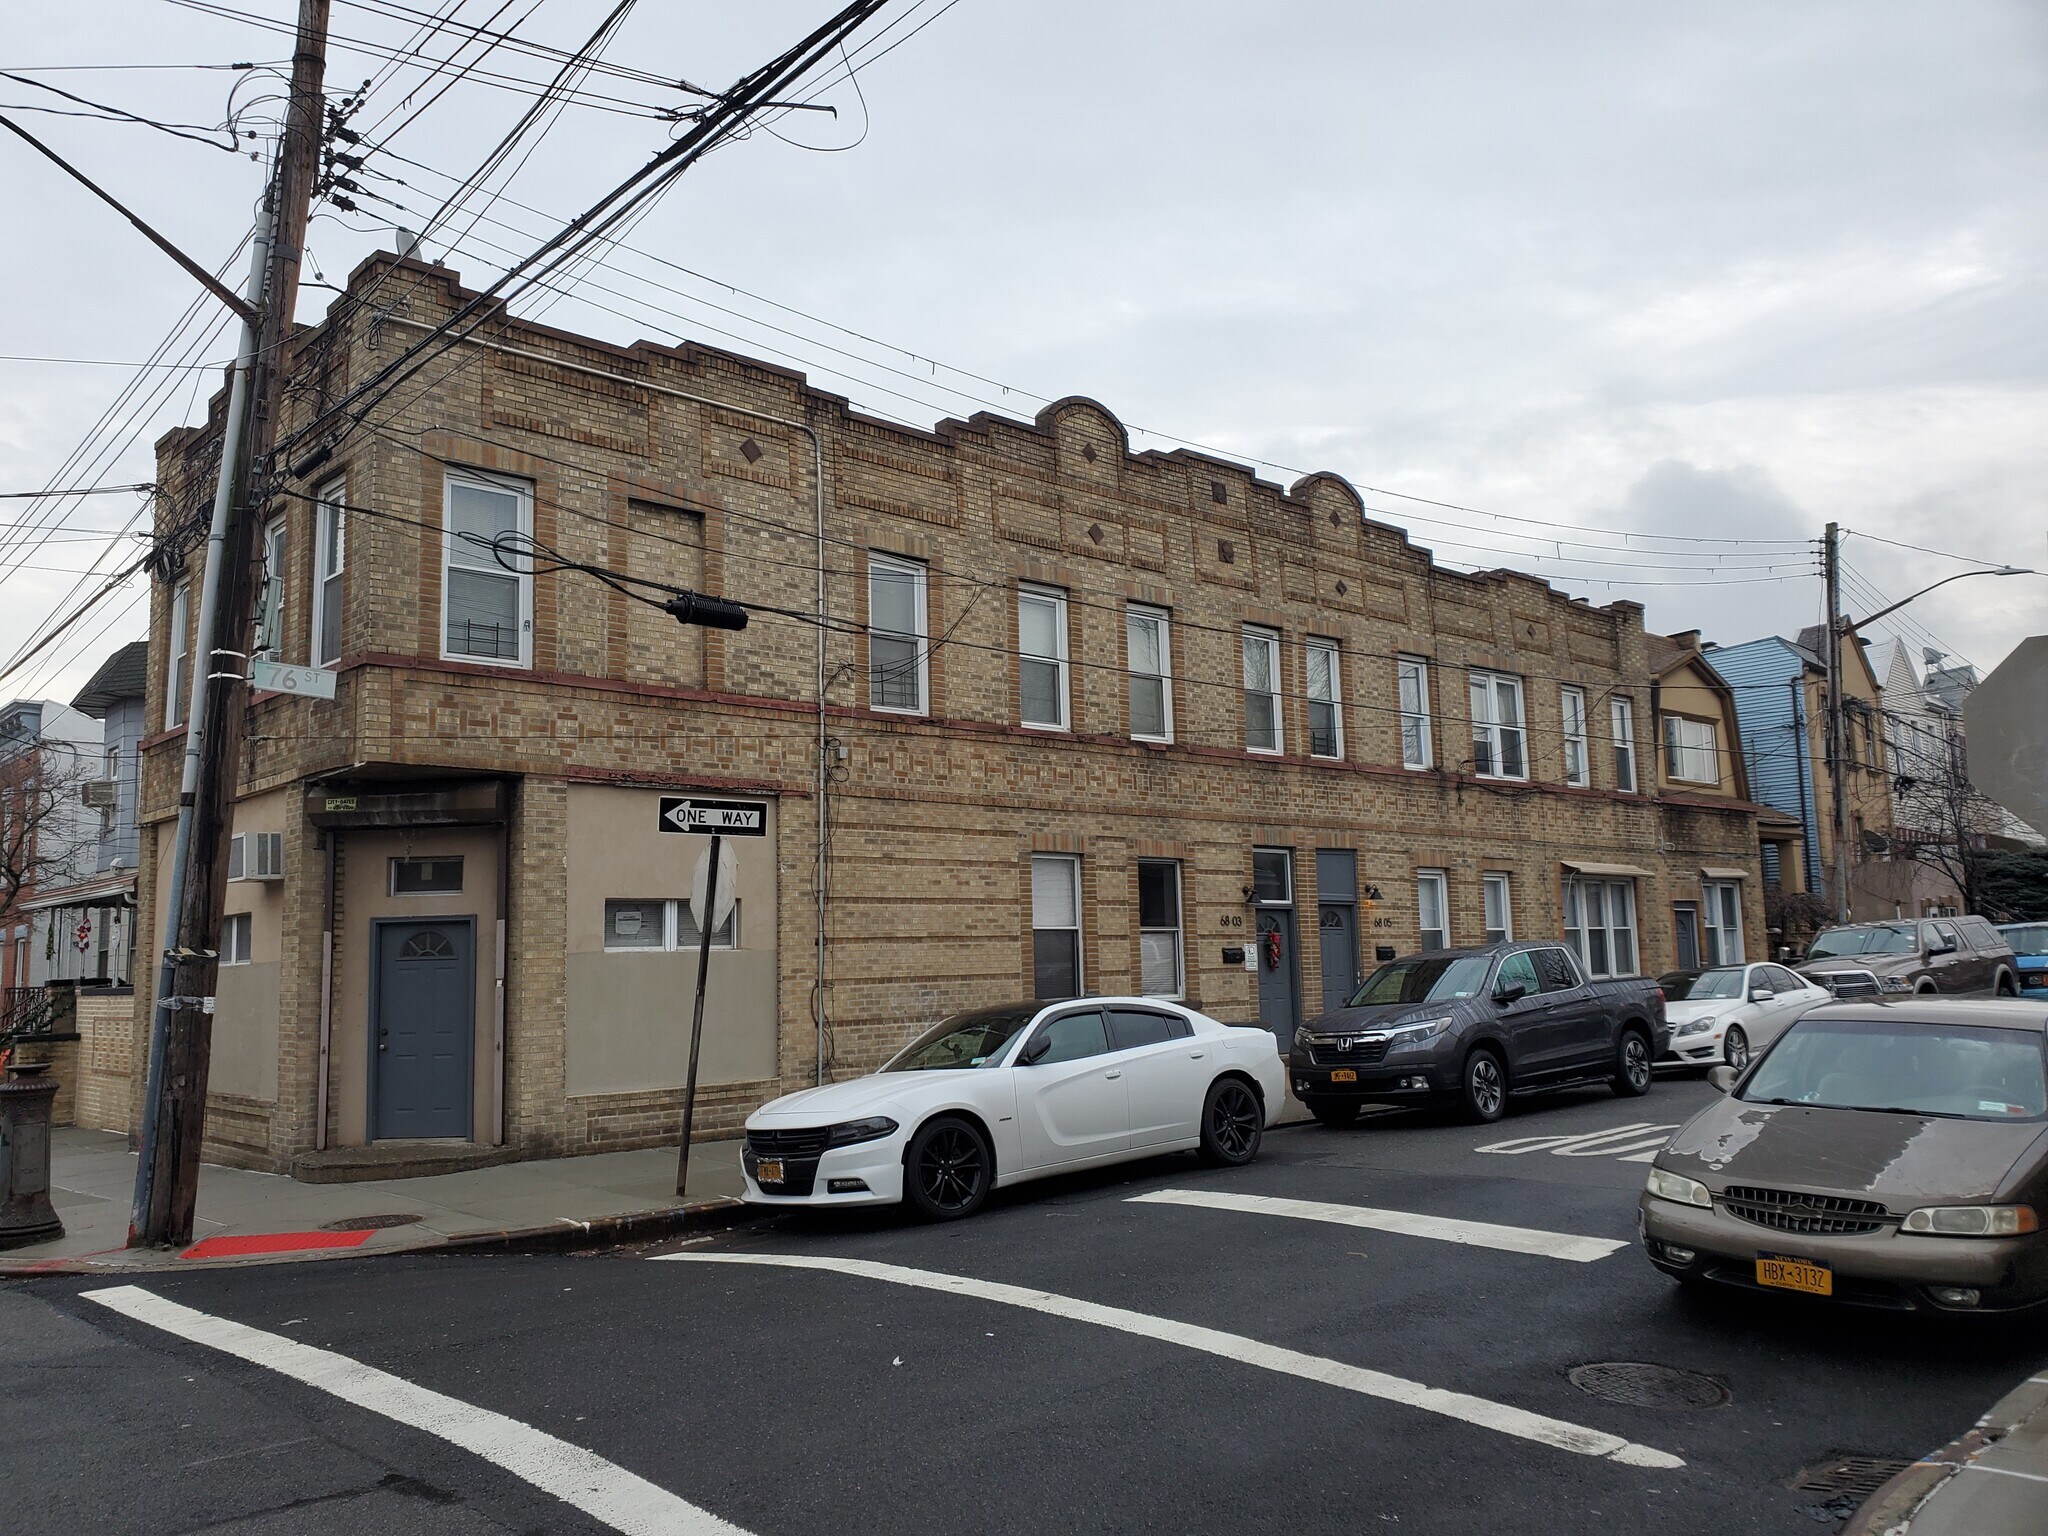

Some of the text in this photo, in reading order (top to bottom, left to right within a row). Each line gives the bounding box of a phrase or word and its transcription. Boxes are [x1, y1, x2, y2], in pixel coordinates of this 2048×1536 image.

[266, 665, 321, 690] 76 ST
[676, 808, 754, 826] ONE WAY
